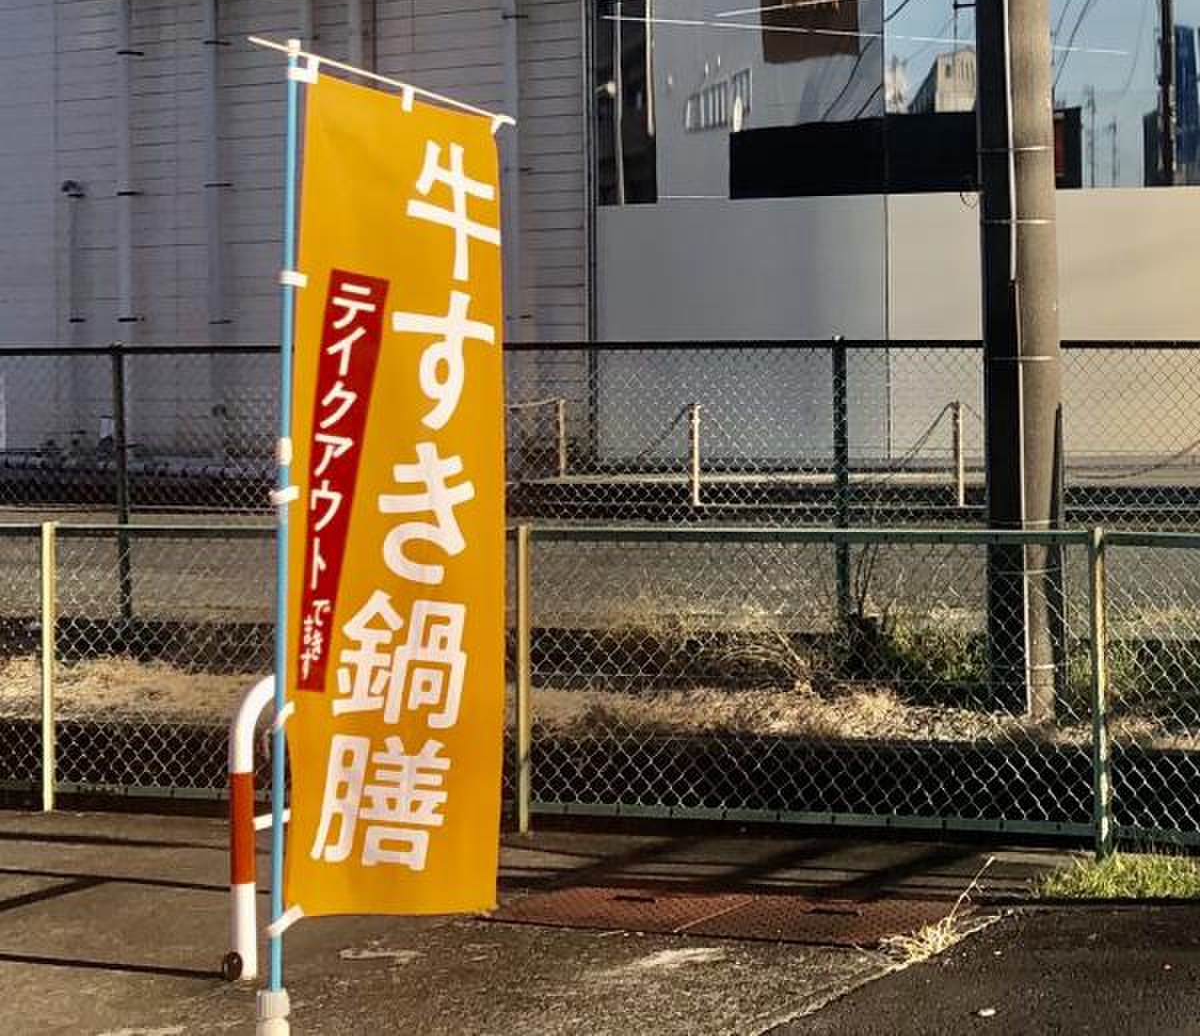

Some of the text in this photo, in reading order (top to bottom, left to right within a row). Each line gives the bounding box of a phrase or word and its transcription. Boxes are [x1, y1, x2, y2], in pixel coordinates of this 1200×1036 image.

[310, 139, 501, 872] 牛すき鍋膳
